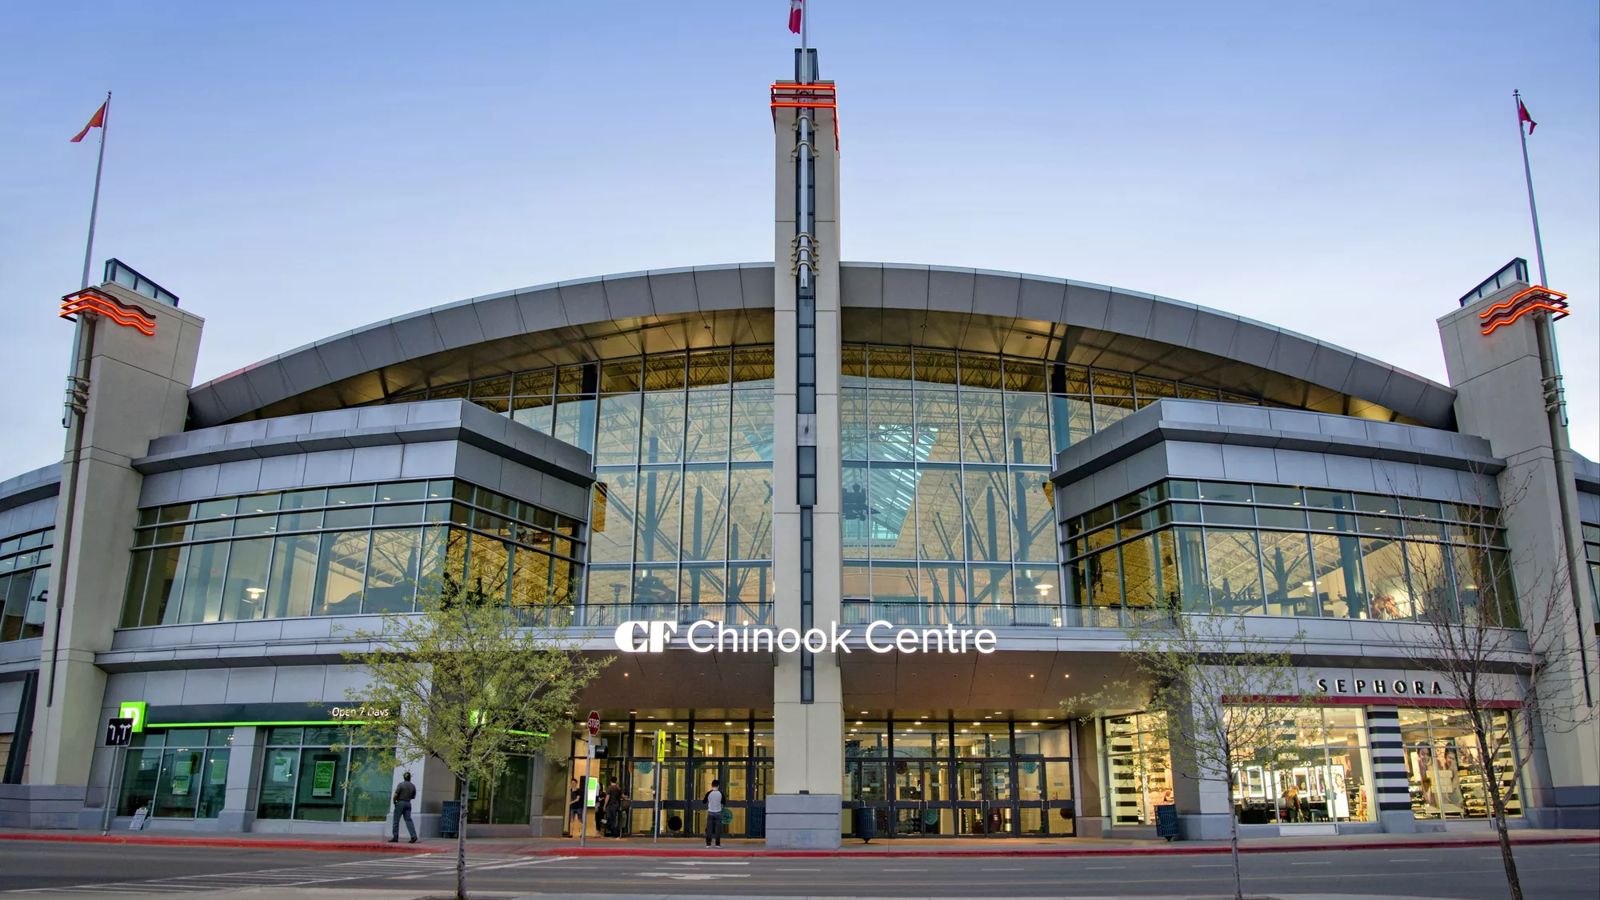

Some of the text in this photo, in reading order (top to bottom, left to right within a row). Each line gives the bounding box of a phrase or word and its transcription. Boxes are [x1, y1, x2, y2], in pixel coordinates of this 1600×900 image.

[687, 620, 852, 654] Chinook
[865, 620, 998, 654] Centre
[1316, 679, 1443, 695] SEPHORA
[332, 707, 357, 719] Open
[359, 706, 365, 717] 7
[588, 718, 600, 728] STOP
